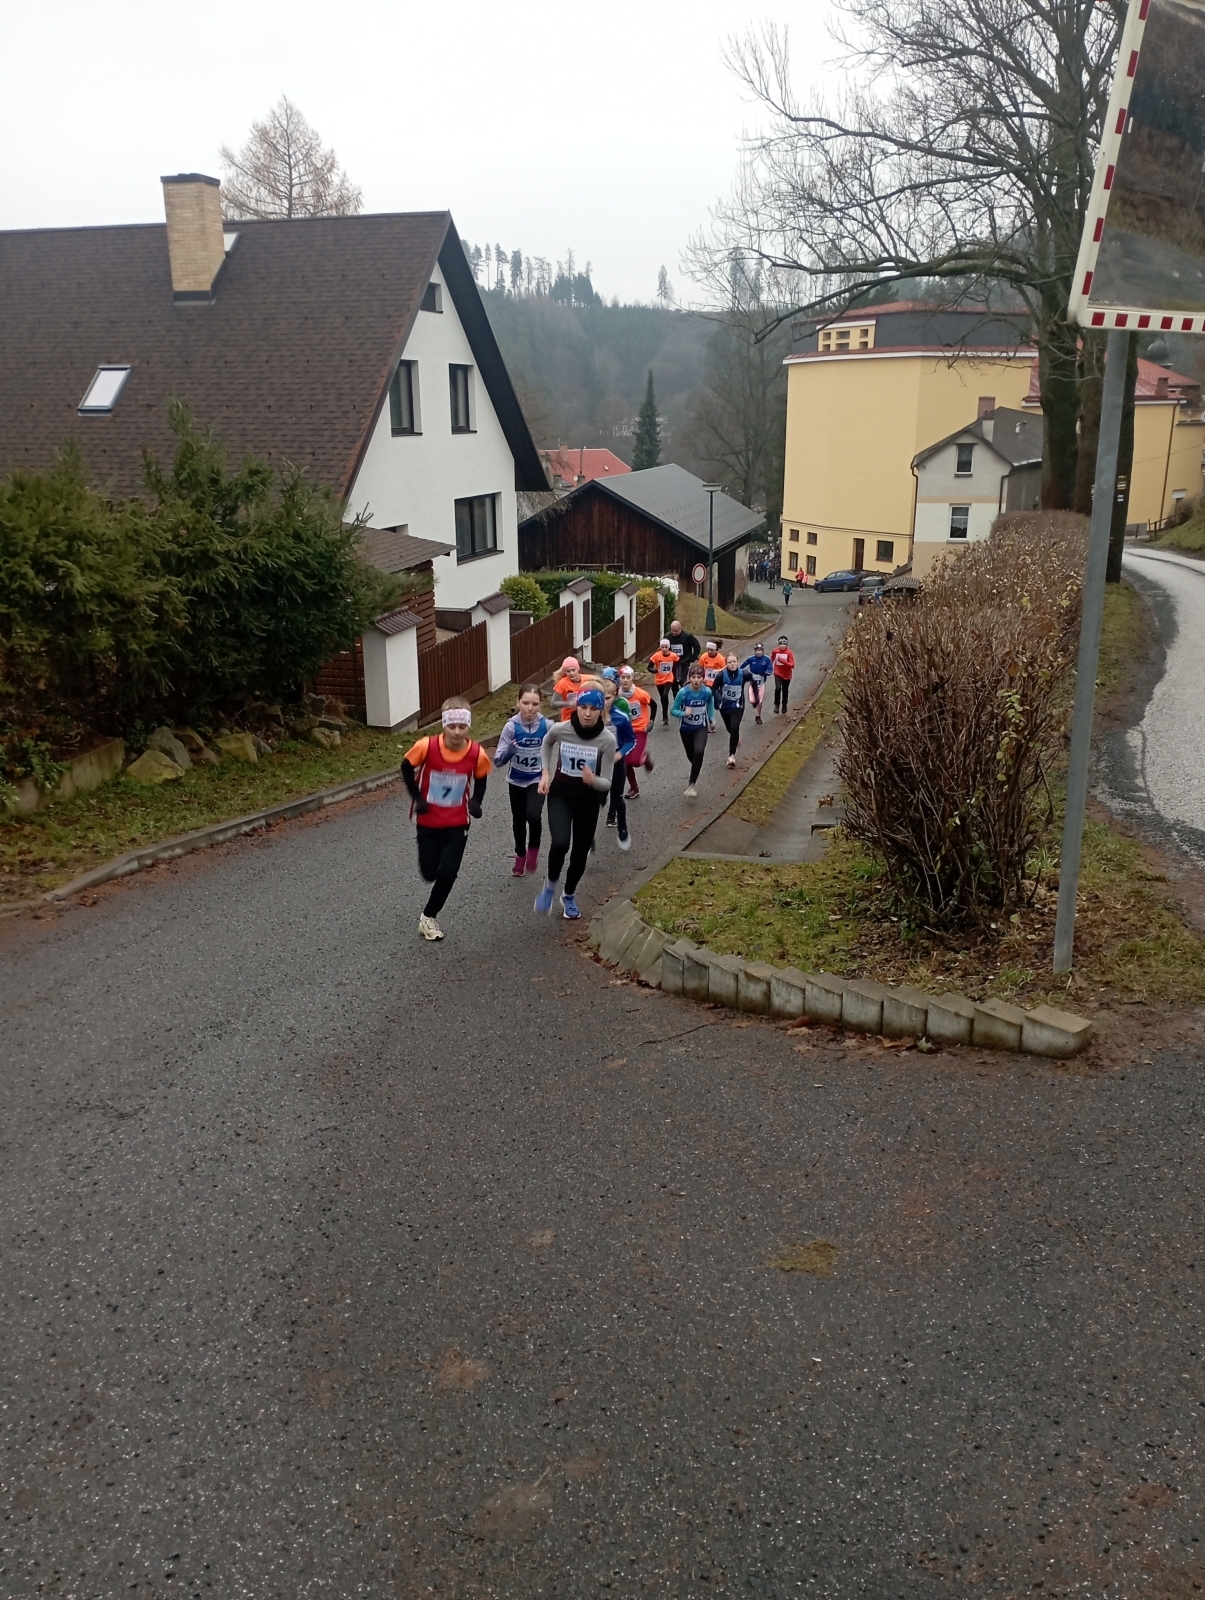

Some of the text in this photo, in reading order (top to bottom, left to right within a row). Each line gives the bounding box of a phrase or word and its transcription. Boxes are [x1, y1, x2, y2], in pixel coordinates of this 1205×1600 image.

[726, 690, 737, 698] 65
[515, 755, 538, 767] 142
[569, 757, 586, 771] 16
[442, 785, 452, 798] 7
